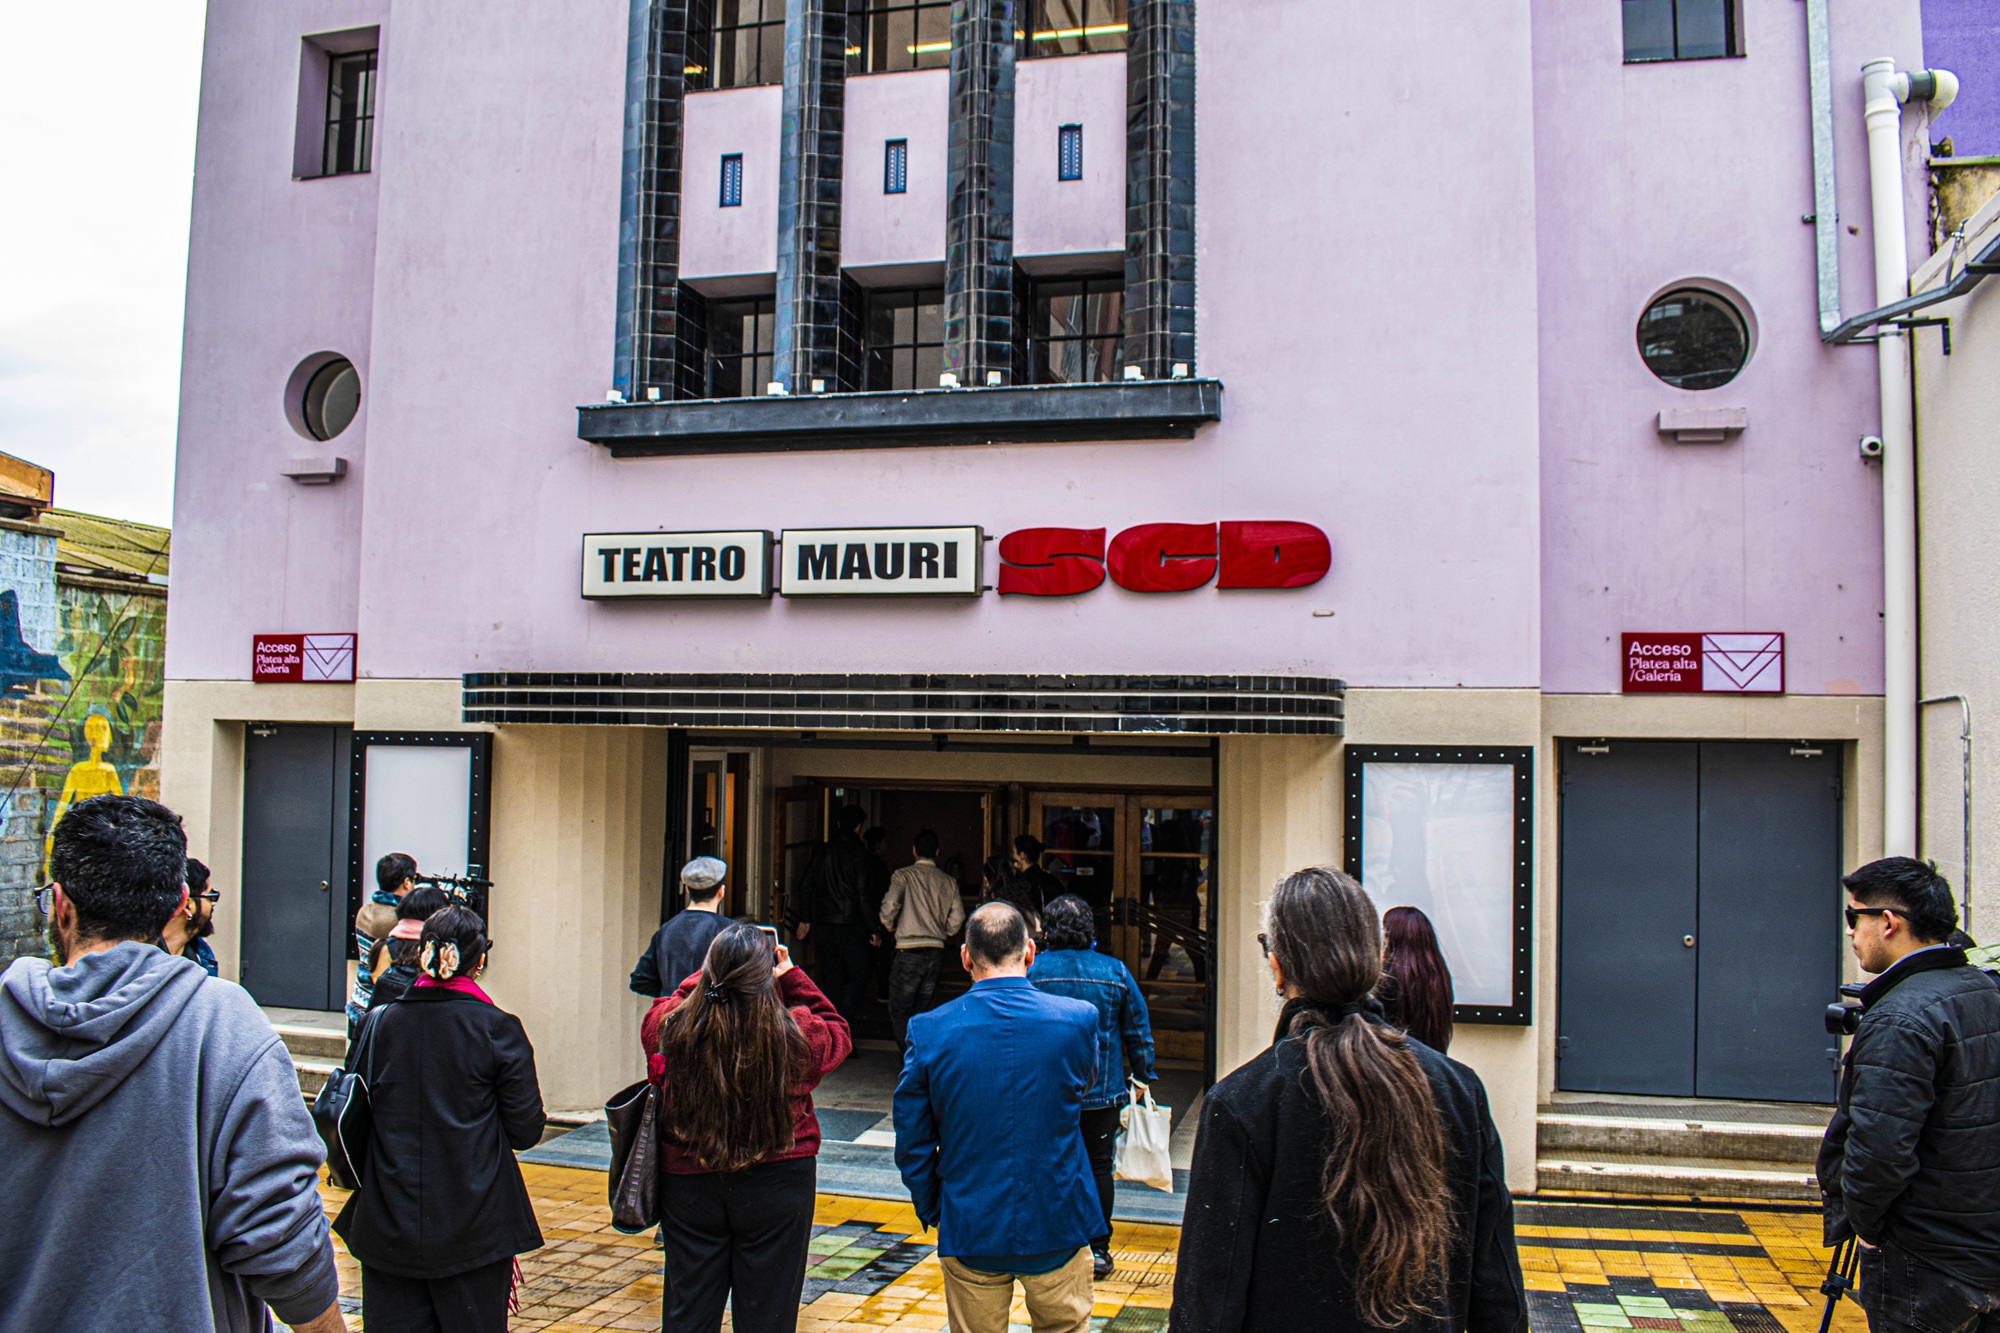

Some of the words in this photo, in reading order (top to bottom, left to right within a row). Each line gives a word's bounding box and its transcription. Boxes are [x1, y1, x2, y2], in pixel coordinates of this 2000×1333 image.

[598, 545, 746, 583] TEATRO
[799, 541, 959, 581] MAURI
[998, 521, 1331, 596] SCD
[256, 641, 297, 653] Acceso
[1629, 641, 1691, 656] Acceso
[256, 654, 283, 664] Platea
[283, 654, 300, 665] alta
[1629, 657, 1670, 669] Platea
[1672, 657, 1697, 669] alta
